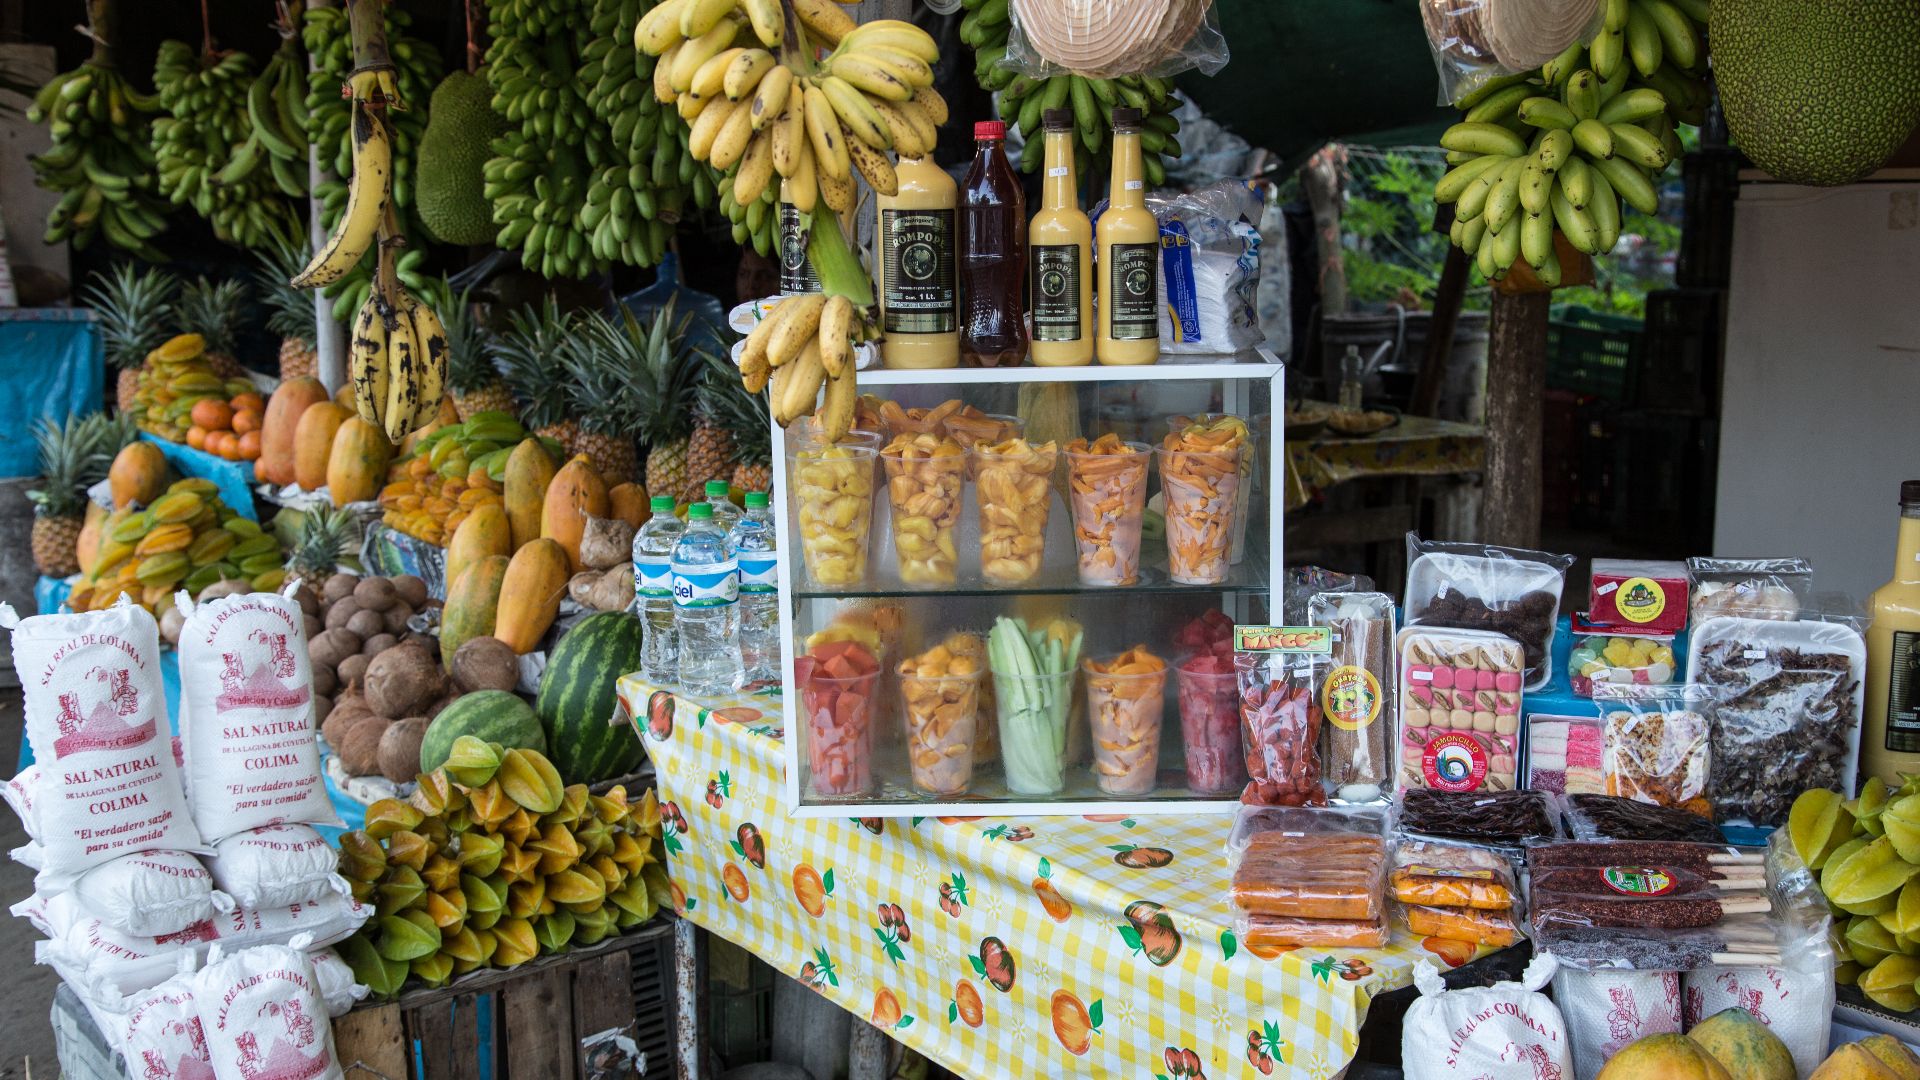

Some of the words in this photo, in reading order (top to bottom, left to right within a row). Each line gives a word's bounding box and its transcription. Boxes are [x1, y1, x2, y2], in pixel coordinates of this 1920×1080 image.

[674, 581, 693, 598] ciel
[1242, 632, 1312, 650] MANGO
[223, 726, 249, 740] SAL
[251, 718, 310, 737] NATURAL
[1432, 735, 1479, 752] JAMONCILLO
[64, 770, 92, 785] SAL
[93, 755, 160, 782] NATURAL
[244, 753, 299, 771] COLIMA
[246, 780, 293, 794] verdadero
[89, 792, 149, 815] COLIMA
[233, 799, 258, 813] para
[260, 797, 273, 807] su
[94, 819, 145, 838] verdadero
[85, 842, 109, 855] para
[111, 840, 125, 849] su
[216, 1007, 230, 1032] SAL
[223, 979, 250, 1007] REAL
[250, 973, 264, 986] DE
[265, 969, 311, 992] COLIMA
[1446, 1038, 1464, 1069] SAL
[1475, 1007, 1494, 1022] DE
[1493, 1002, 1547, 1036] COLIMA
